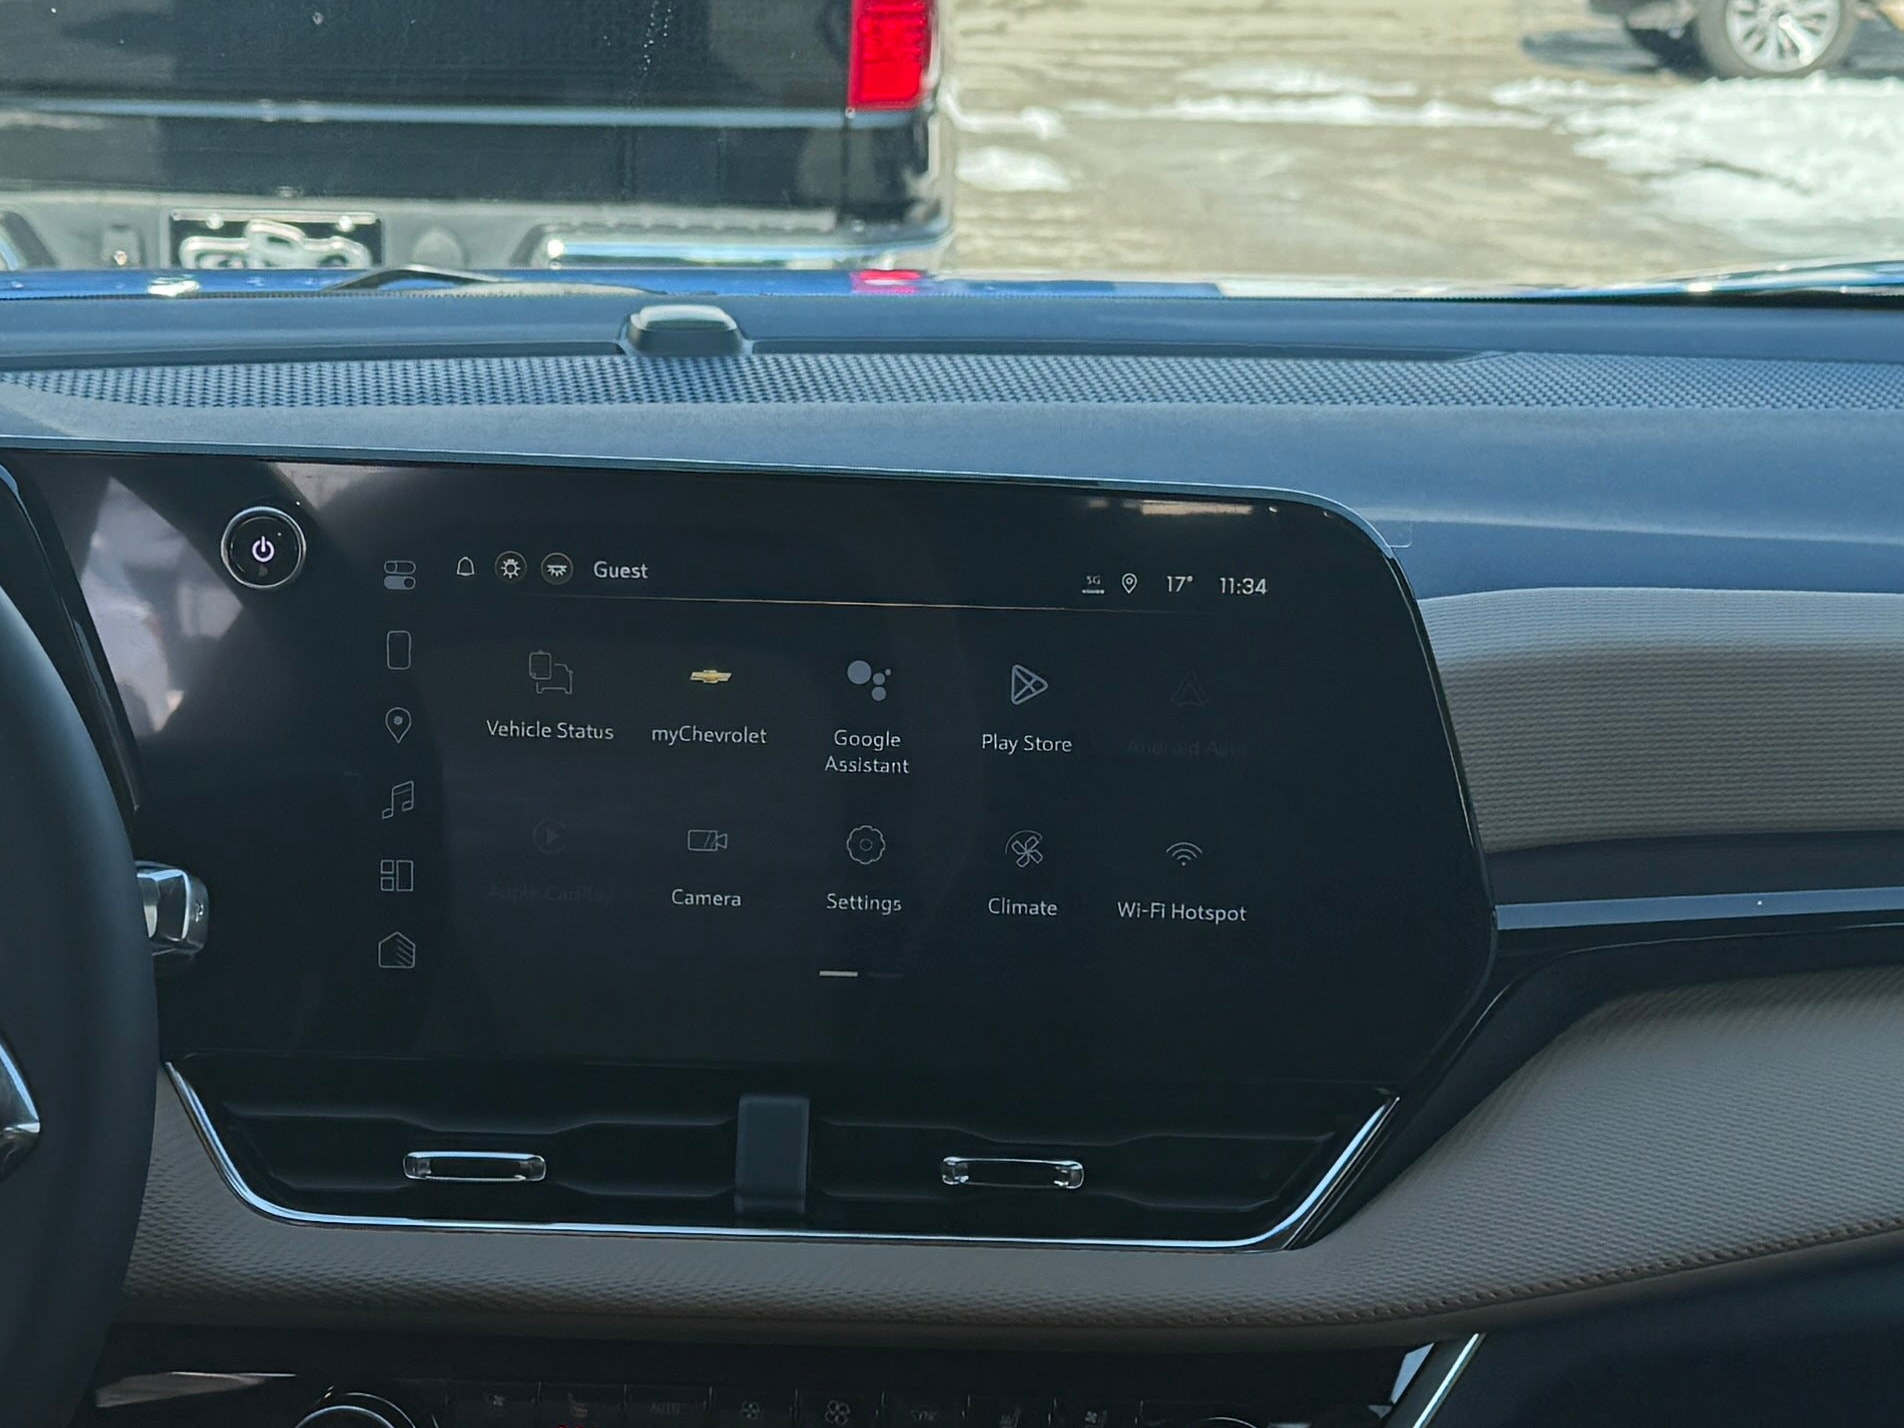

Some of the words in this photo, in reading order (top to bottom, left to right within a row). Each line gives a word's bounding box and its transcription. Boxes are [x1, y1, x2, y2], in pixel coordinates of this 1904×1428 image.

[592, 559, 649, 578] Guest
[1166, 575, 1194, 592] 17°
[1219, 577, 1268, 595] 11:34
[485, 719, 552, 739] Vehicle
[556, 721, 615, 740] Status
[651, 724, 768, 746] myChevrolet
[833, 728, 902, 752] Google
[981, 732, 1018, 755] Play
[1023, 734, 1073, 753] Store
[824, 754, 910, 774] Assistant
[671, 888, 742, 907] Camera
[825, 892, 903, 917] Settings
[987, 897, 1058, 917] Climate
[1117, 901, 1166, 920] Wi-Fi
[1171, 903, 1247, 925] Hotspot
